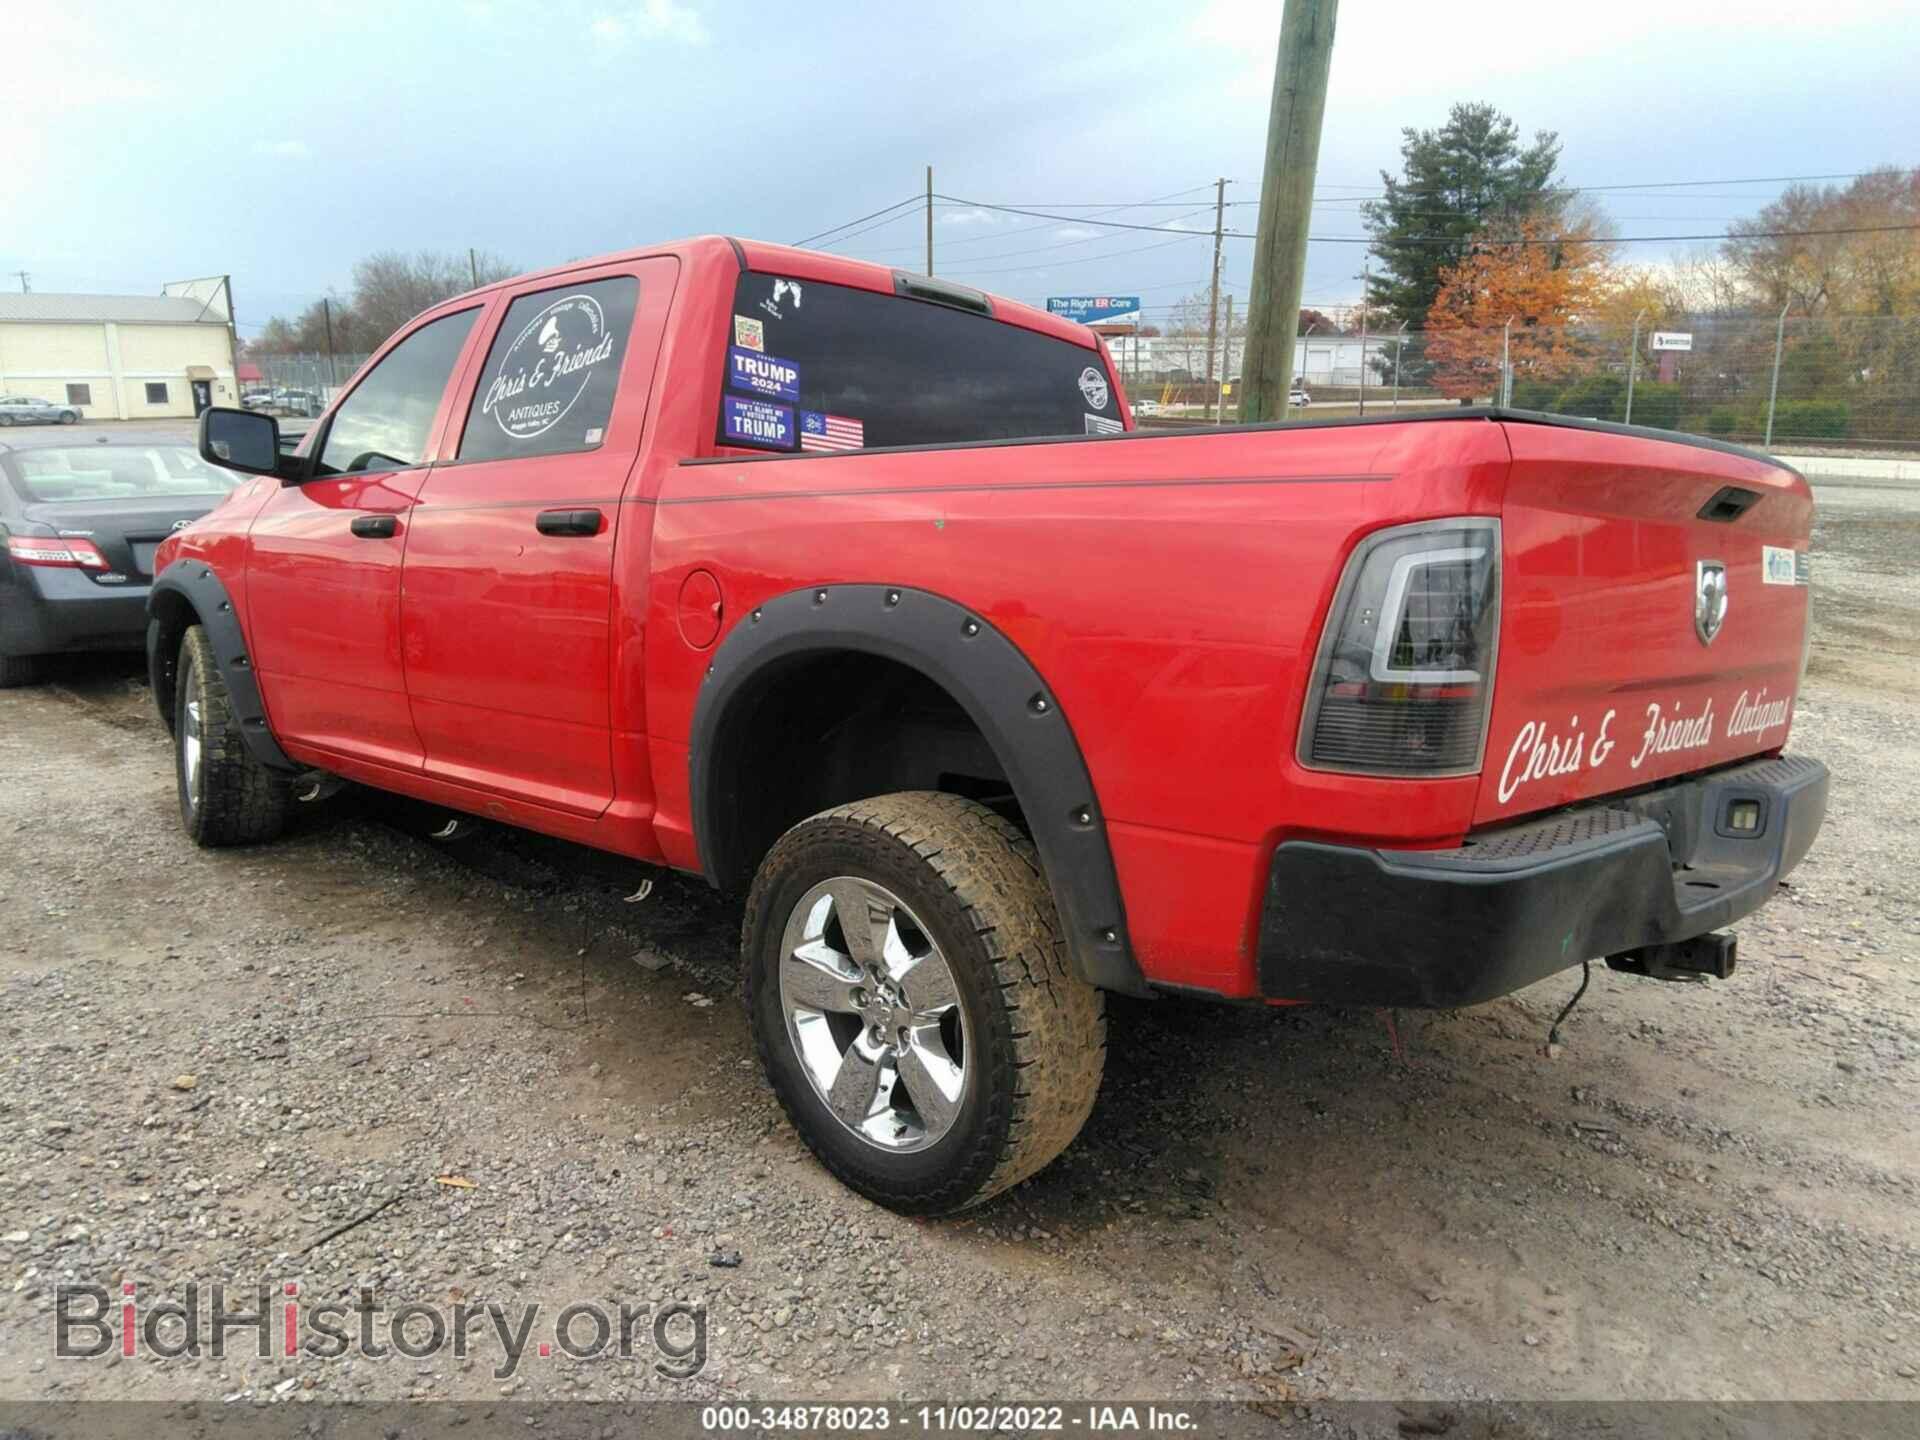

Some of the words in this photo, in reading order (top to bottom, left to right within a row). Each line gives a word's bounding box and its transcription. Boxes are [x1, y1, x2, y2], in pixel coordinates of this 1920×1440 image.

[1052, 299, 1069, 308] The
[1070, 299, 1093, 310] Right
[1095, 299, 1109, 308] ER
[1110, 299, 1131, 308] Care
[482, 367, 527, 413] Chris
[529, 358, 546, 388] &
[544, 331, 614, 387] Friends
[734, 354, 797, 384] TRUMP
[751, 376, 782, 392] 2024
[508, 401, 561, 422] ANTIQUES
[733, 416, 786, 439] TRUMP
[1497, 714, 1585, 804] Chris
[1589, 708, 1617, 768] &
[1630, 697, 1715, 769] Friends
[1727, 687, 1791, 744] Antiques
